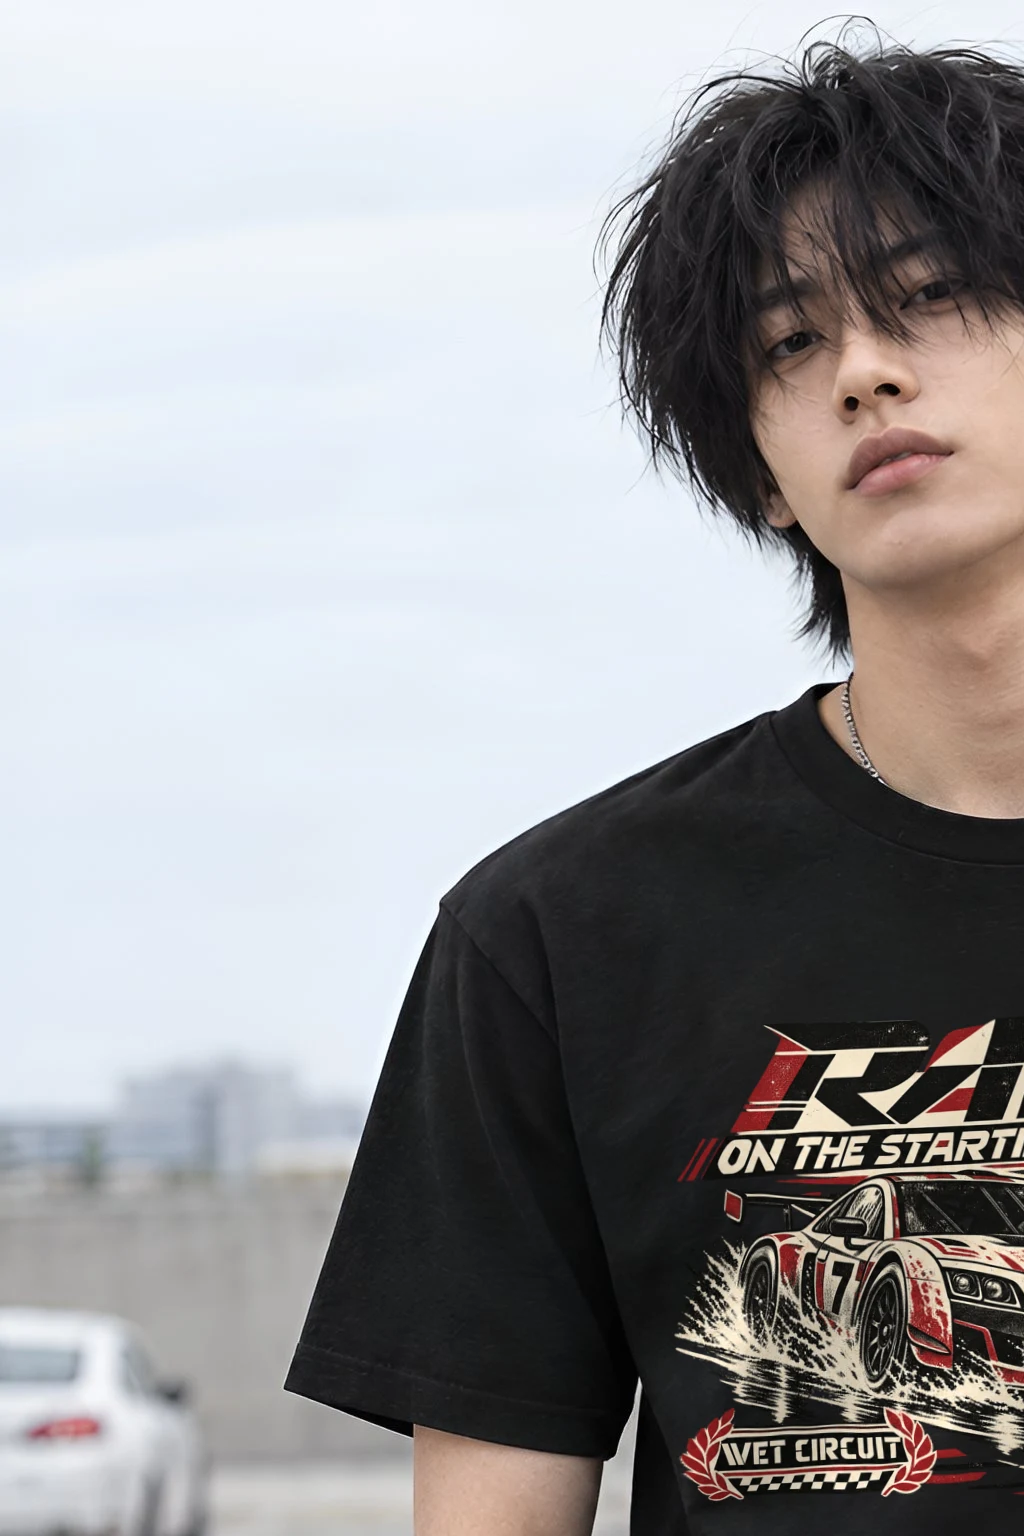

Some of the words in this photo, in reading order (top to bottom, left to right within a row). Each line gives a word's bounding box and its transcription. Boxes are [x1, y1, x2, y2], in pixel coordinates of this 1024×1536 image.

[716, 1137, 787, 1176] ON
[793, 1134, 872, 1171] THE
[831, 1260, 856, 1316] 7
[720, 1439, 787, 1467] WET
[794, 1435, 902, 1463] CIRCUIT
